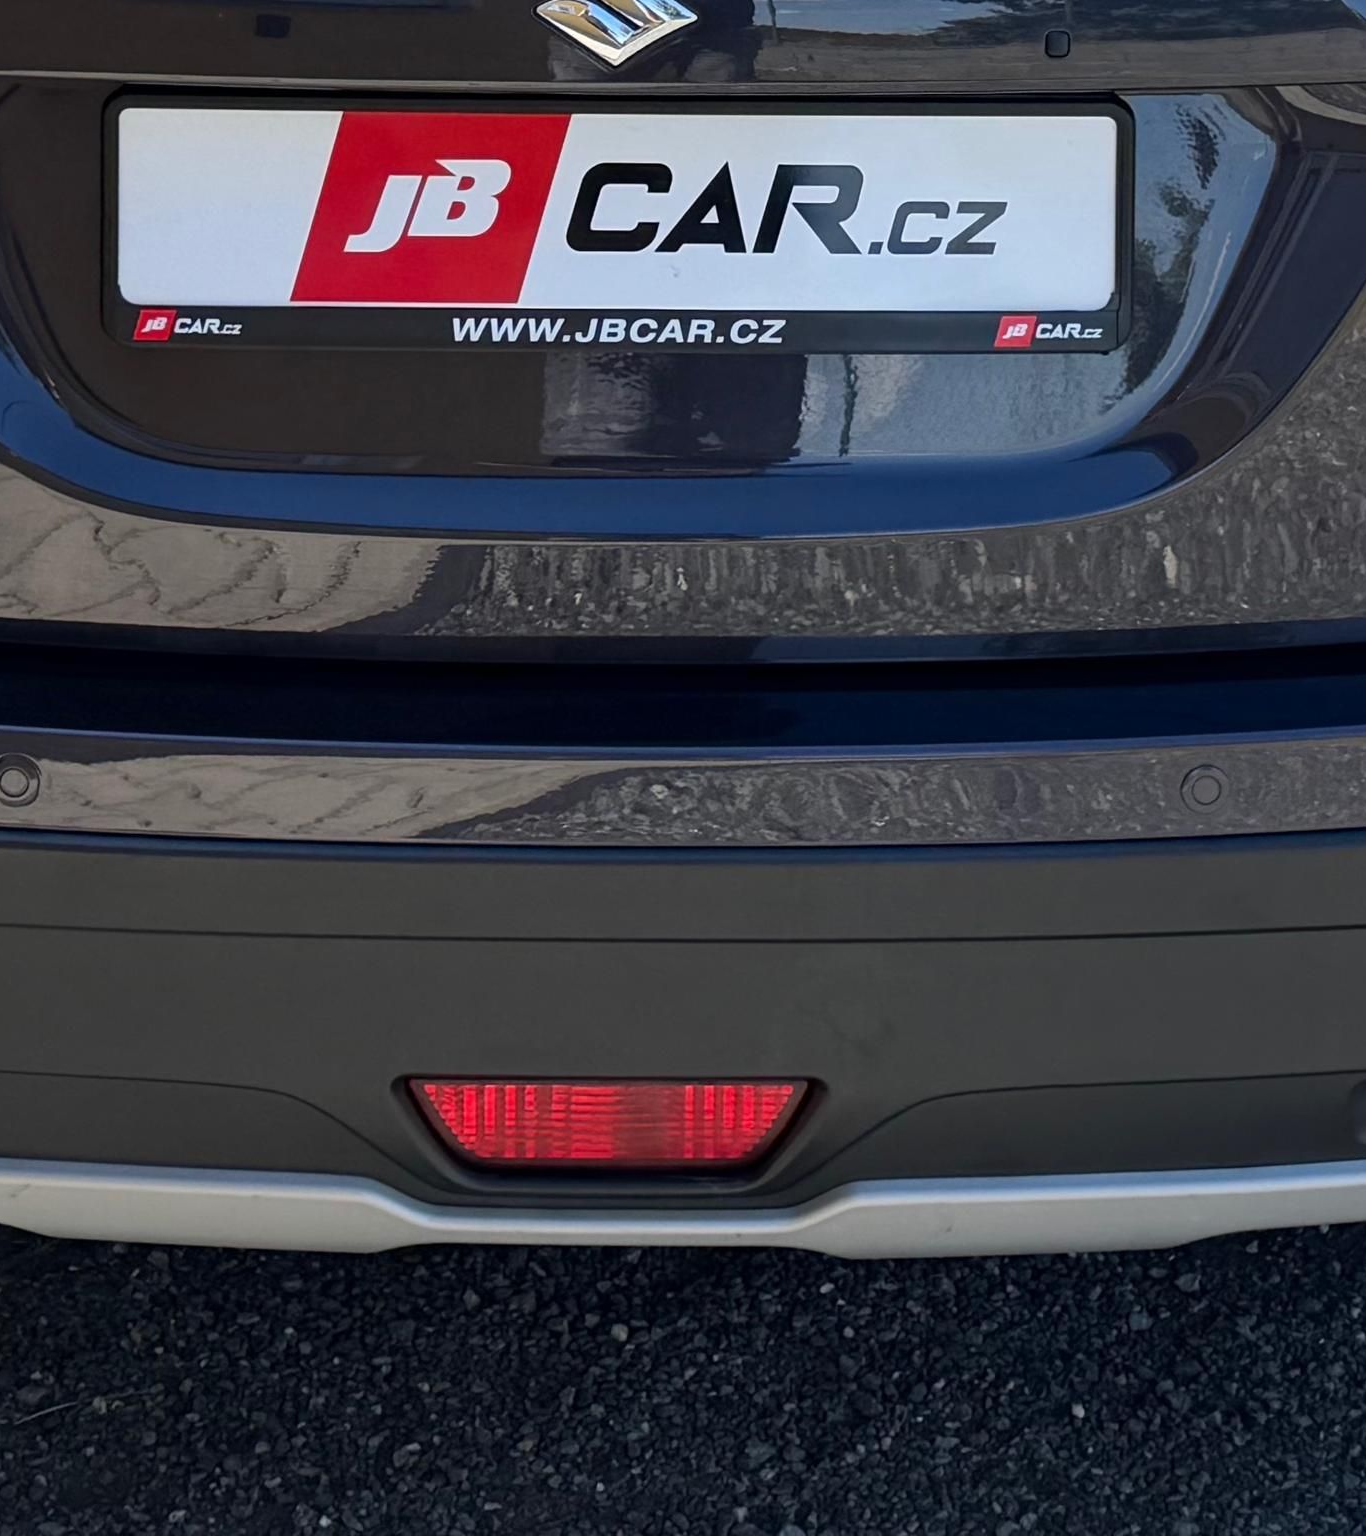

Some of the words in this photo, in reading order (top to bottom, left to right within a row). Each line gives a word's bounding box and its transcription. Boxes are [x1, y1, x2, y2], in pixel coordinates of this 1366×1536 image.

[343, 158, 512, 253] JB
[141, 317, 168, 333] JB
[451, 317, 787, 344] WWW.JBCAR.CZ
[1002, 323, 1028, 339] JB
